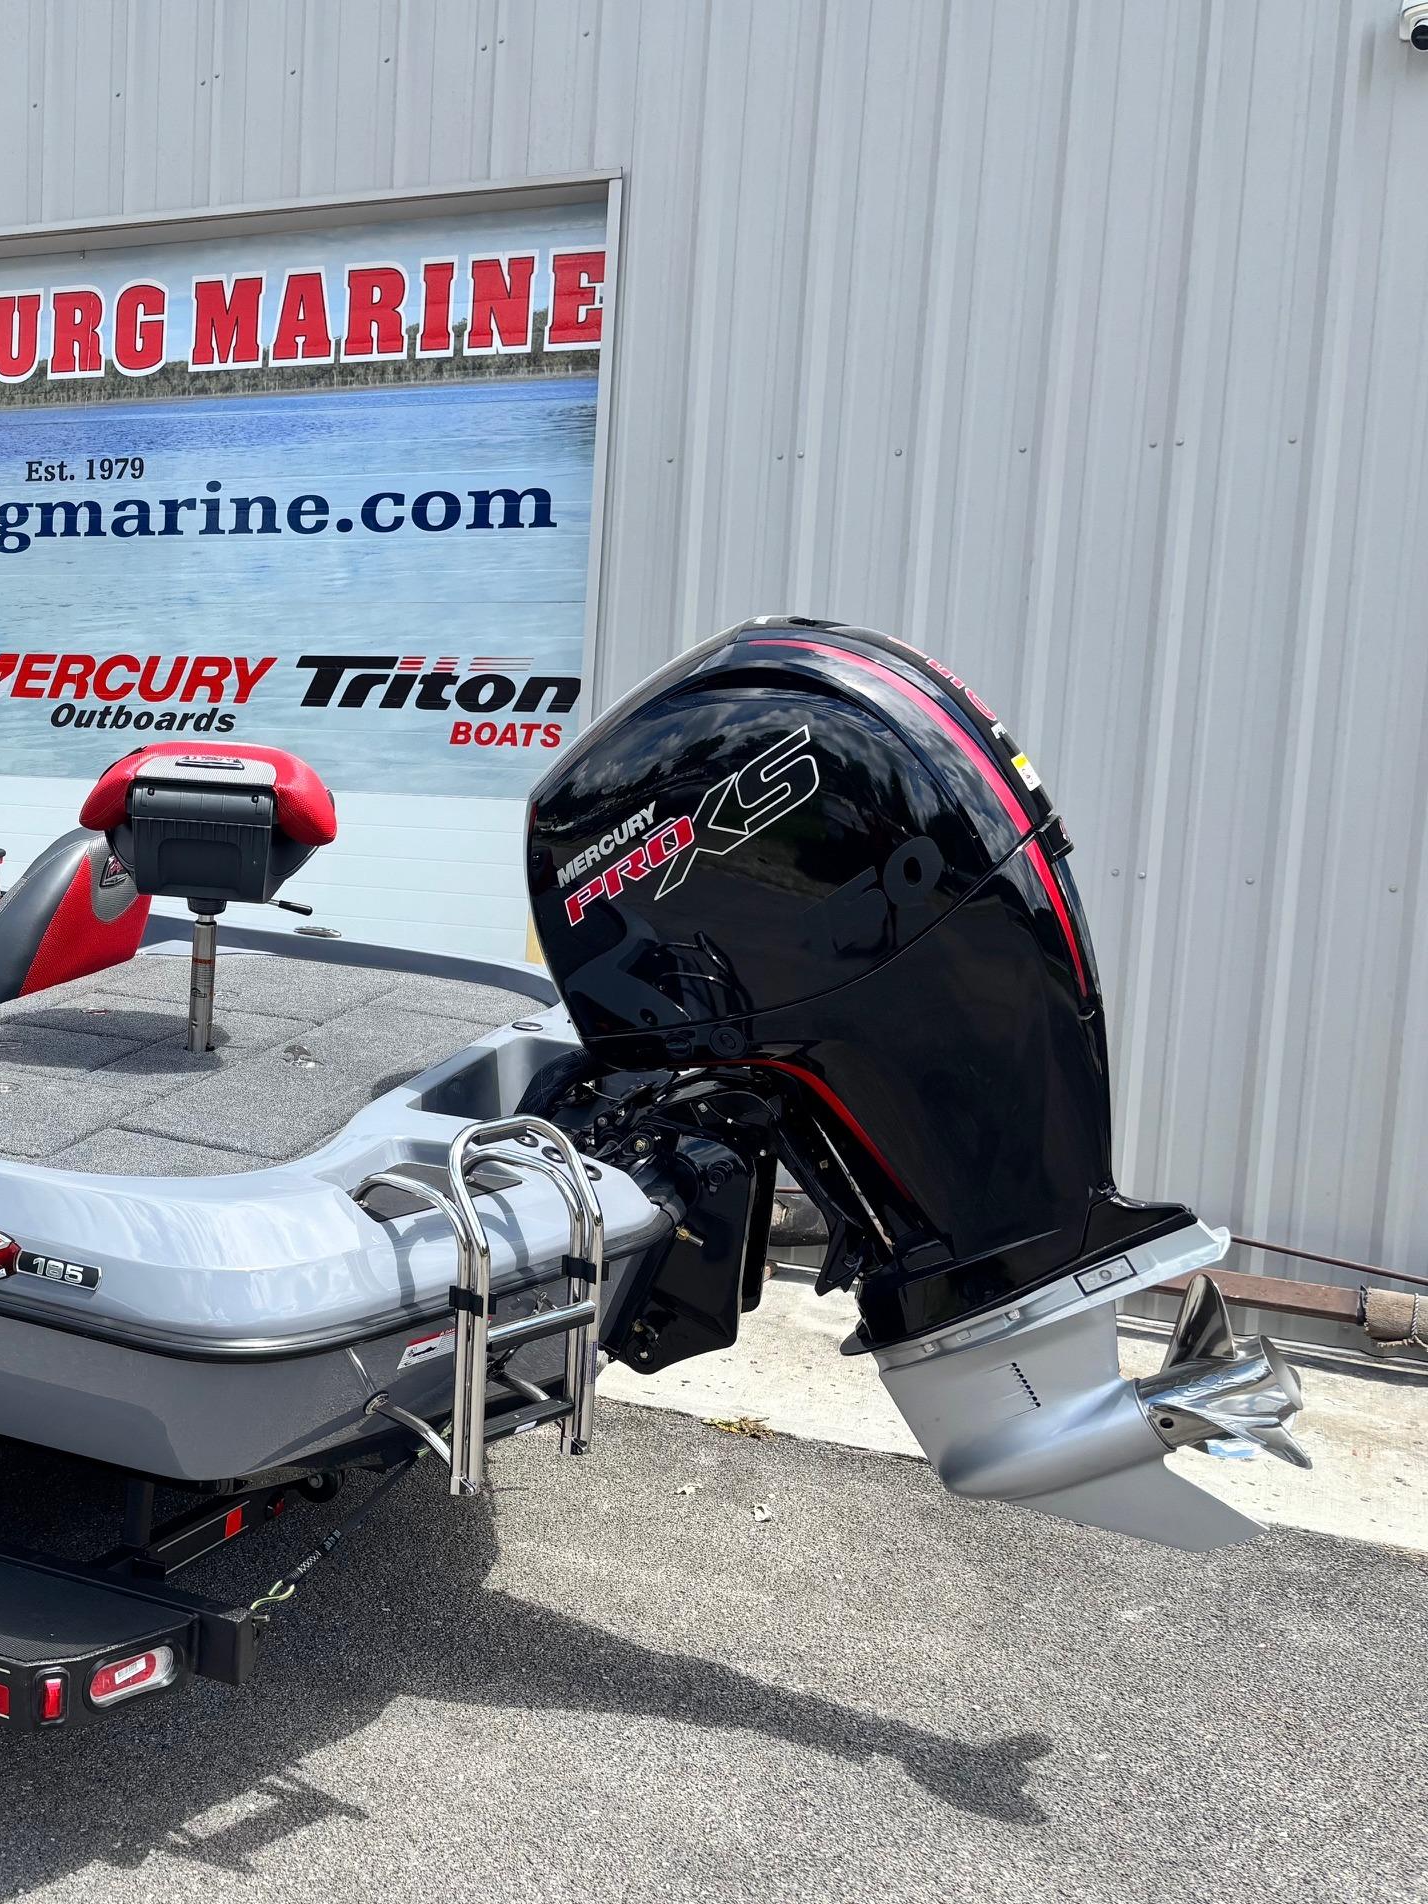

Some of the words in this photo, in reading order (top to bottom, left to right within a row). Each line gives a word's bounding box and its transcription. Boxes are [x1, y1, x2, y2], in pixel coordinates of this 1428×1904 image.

[188, 245, 606, 372] MARINE
[25, 458, 75, 483] Est.
[85, 457, 145, 481] 1979
[296, 655, 581, 713] Triton
[49, 702, 237, 733] Outboards
[449, 721, 563, 748] BOATS
[556, 800, 657, 889] MERCURY
[564, 815, 695, 927] PRO
[31, 1256, 84, 1284] 185
